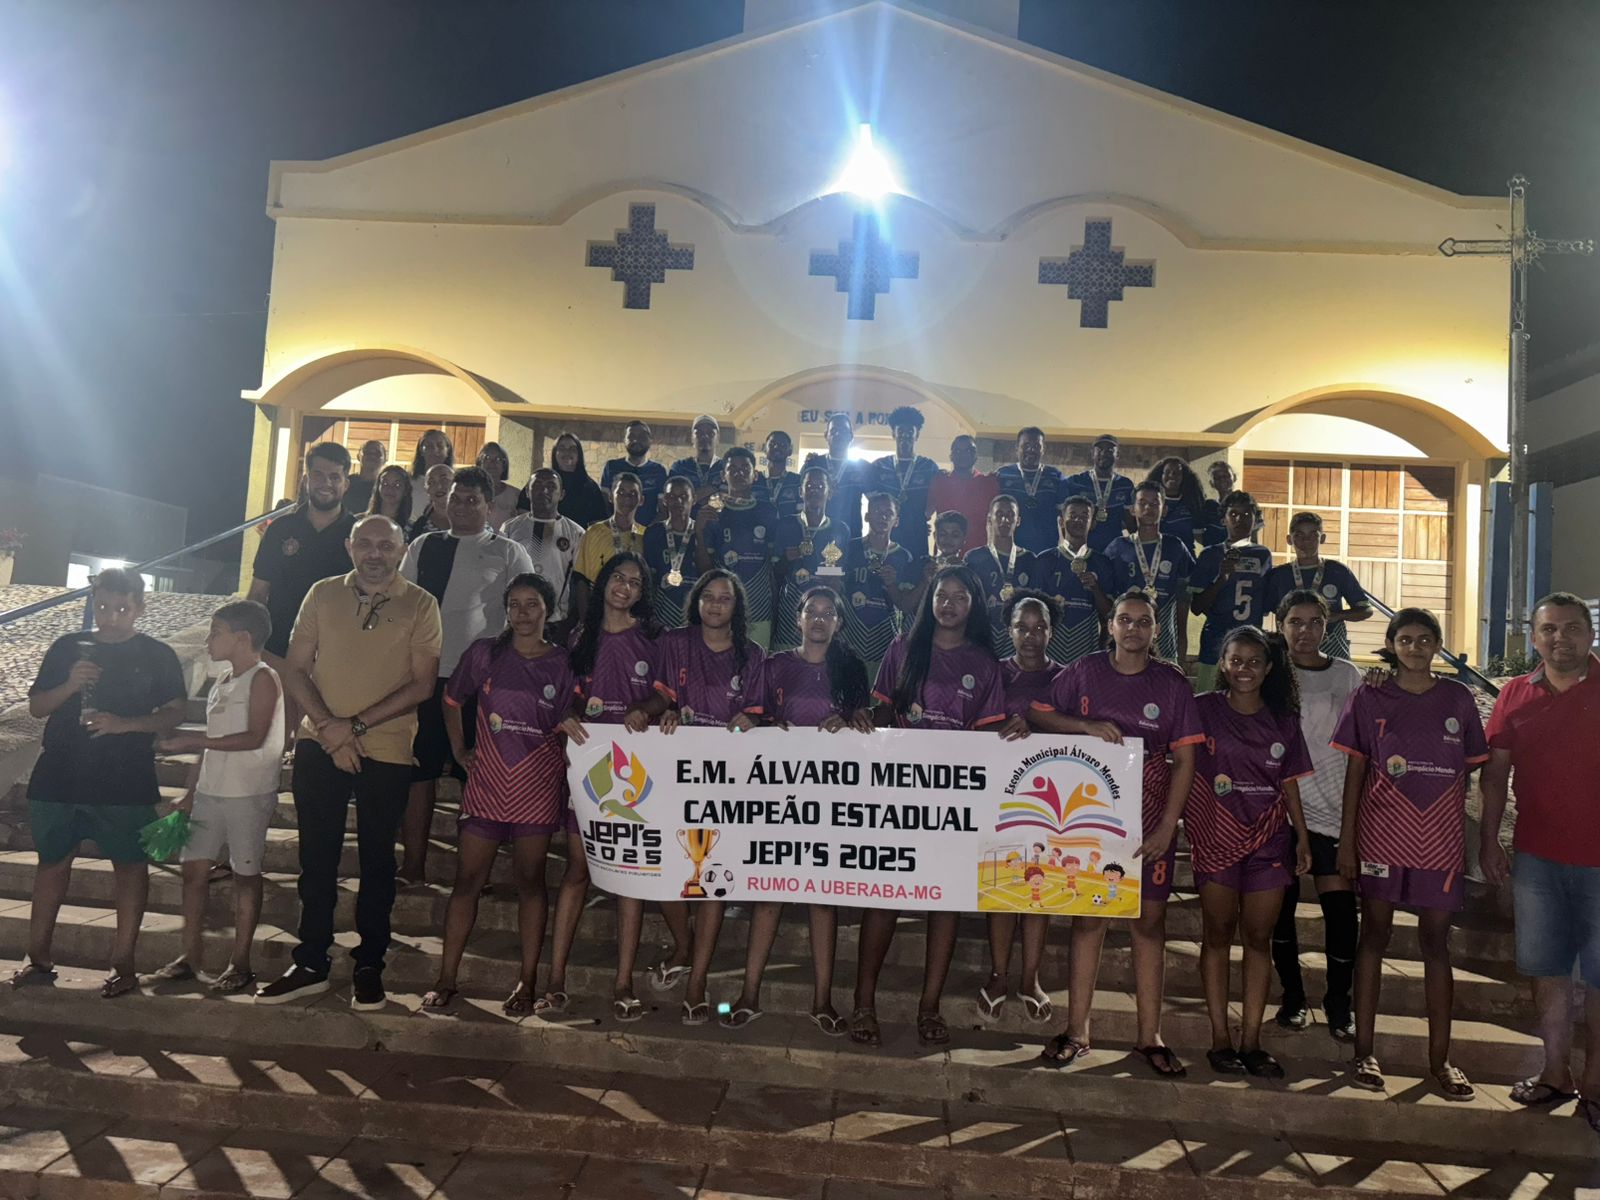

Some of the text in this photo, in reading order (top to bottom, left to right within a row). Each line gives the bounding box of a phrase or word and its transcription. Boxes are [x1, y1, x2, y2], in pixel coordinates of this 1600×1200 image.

[801, 410, 818, 422] EU
[855, 411, 864, 424] A
[723, 528, 732, 543] 9
[854, 567, 868, 583] 10
[990, 571, 998, 587] 2
[1055, 571, 1062, 587] 7
[1128, 561, 1136, 577] 3
[1232, 580, 1253, 621] 5
[776, 688, 784, 705] 3
[1081, 695, 1089, 716] 8
[1375, 718, 1387, 738] 7
[1206, 736, 1216, 756] 9
[676, 754, 986, 791] E.M. ÁLVARO MENDES
[1004, 744, 1121, 800] Escola Municipal Álvaro Mendes
[684, 794, 979, 832] CAMPEÃO ESTADUAL
[585, 840, 662, 864] 2025
[743, 840, 916, 872] JEPI'S 2025
[1152, 860, 1167, 885] 8
[747, 876, 943, 900] RUMO A UBERABA-MG
